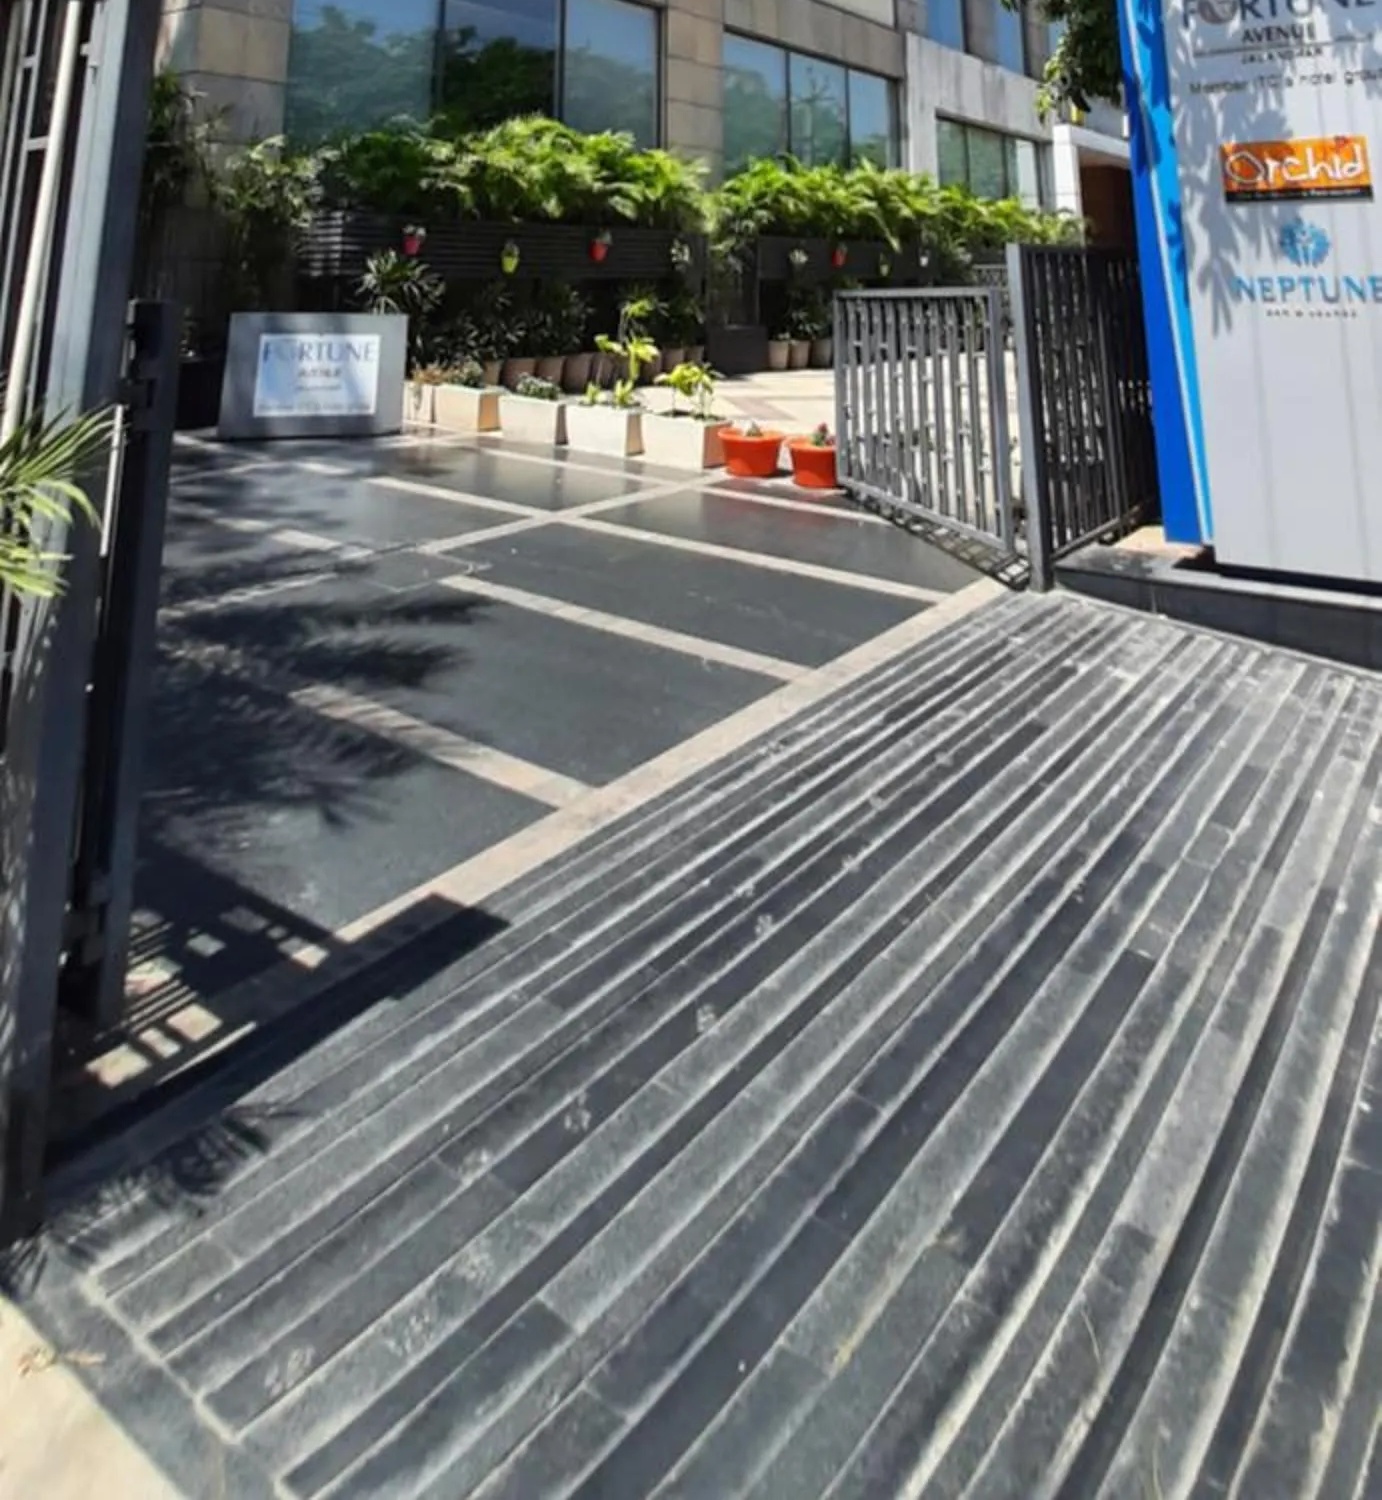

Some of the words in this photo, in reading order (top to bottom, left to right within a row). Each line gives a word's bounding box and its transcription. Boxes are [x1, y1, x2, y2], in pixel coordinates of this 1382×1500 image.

[1241, 21, 1316, 44] AVENUE
[1225, 142, 1365, 184] Orchid
[1231, 275, 1382, 304] NEPTUNE
